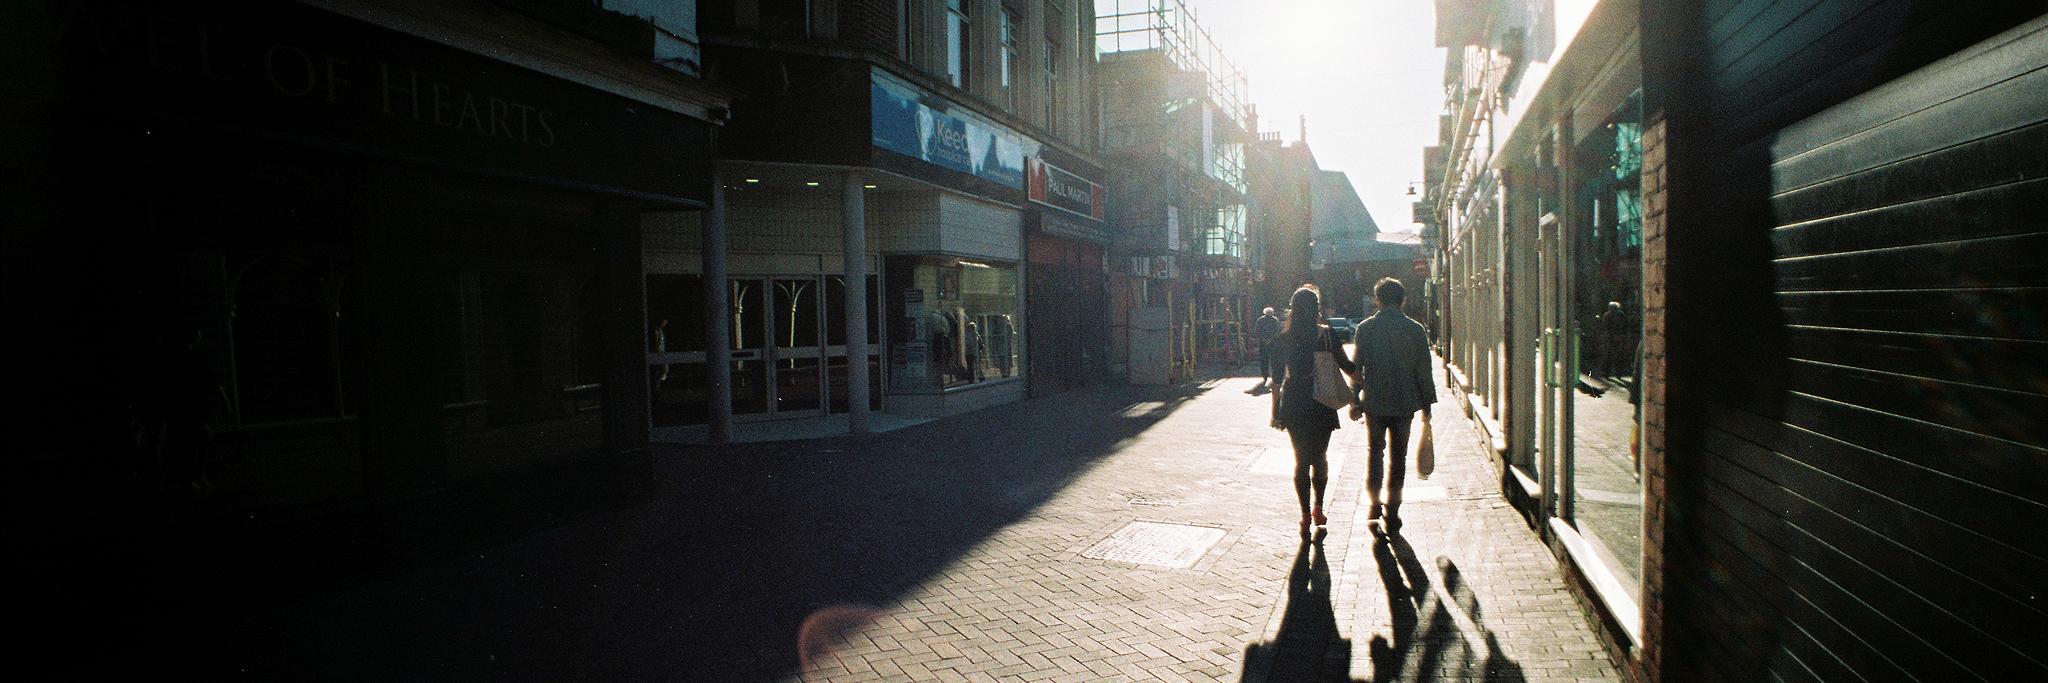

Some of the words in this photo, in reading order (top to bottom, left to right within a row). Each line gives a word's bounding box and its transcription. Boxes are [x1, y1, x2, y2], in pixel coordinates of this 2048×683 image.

[263, 43, 350, 105] OF
[379, 61, 557, 149] HEARTS
[1048, 178, 1067, 197] PAUL
